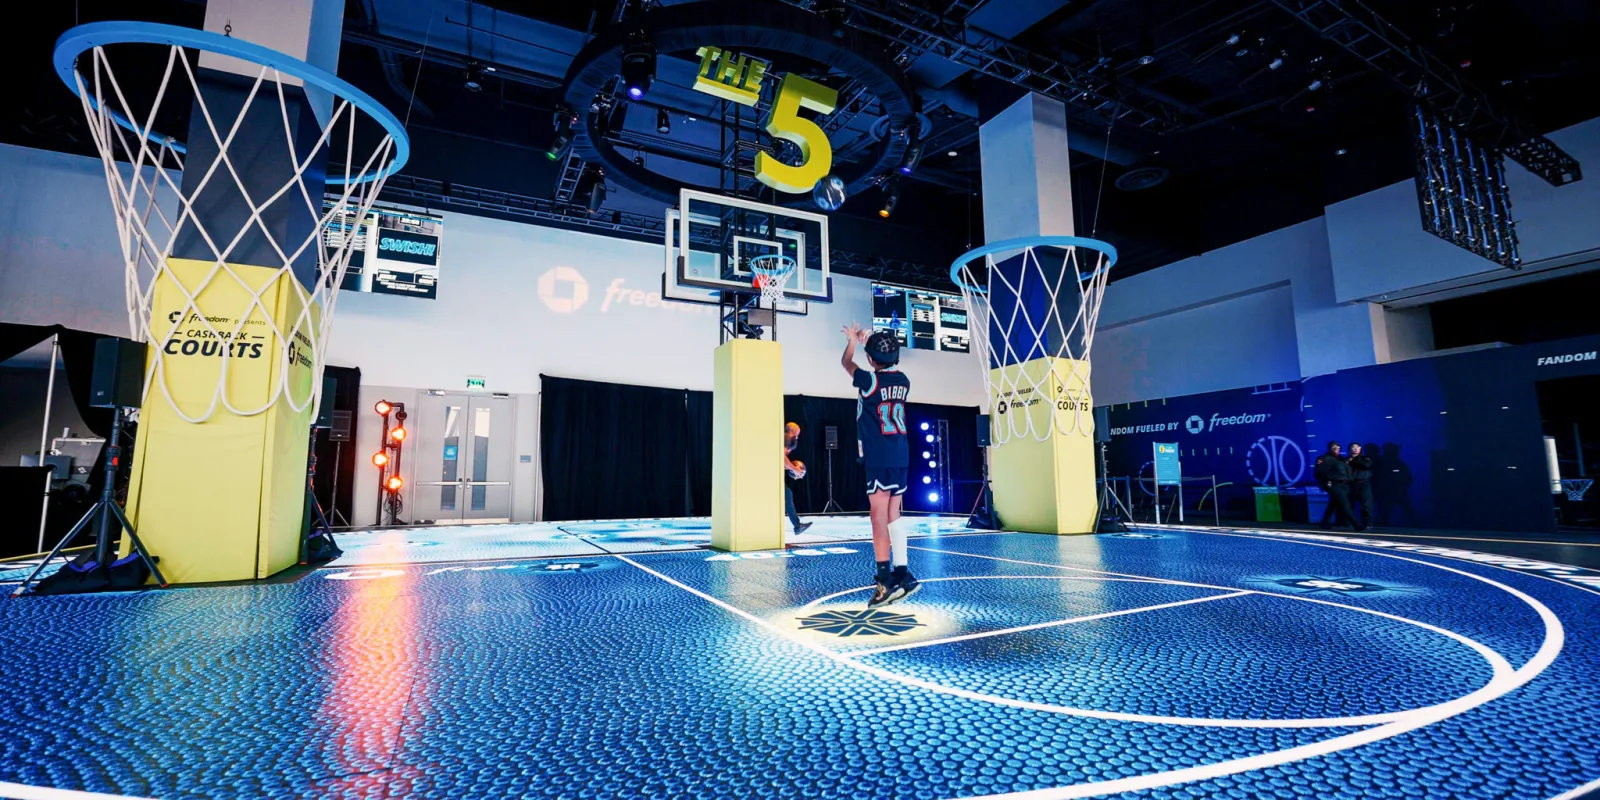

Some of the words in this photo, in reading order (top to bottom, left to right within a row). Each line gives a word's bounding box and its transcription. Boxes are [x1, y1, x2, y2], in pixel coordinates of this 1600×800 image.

[695, 45, 767, 94] THE
[754, 72, 838, 194] 5
[379, 237, 436, 256] SWISH!
[1537, 351, 1597, 366] FANDOM
[880, 385, 907, 401] BIBBY
[878, 402, 907, 435] 10
[1208, 413, 1267, 432] freedom
[1110, 426, 1134, 436] NDOM
[1135, 423, 1166, 433] FUELED
[1167, 422, 1179, 431] BY
